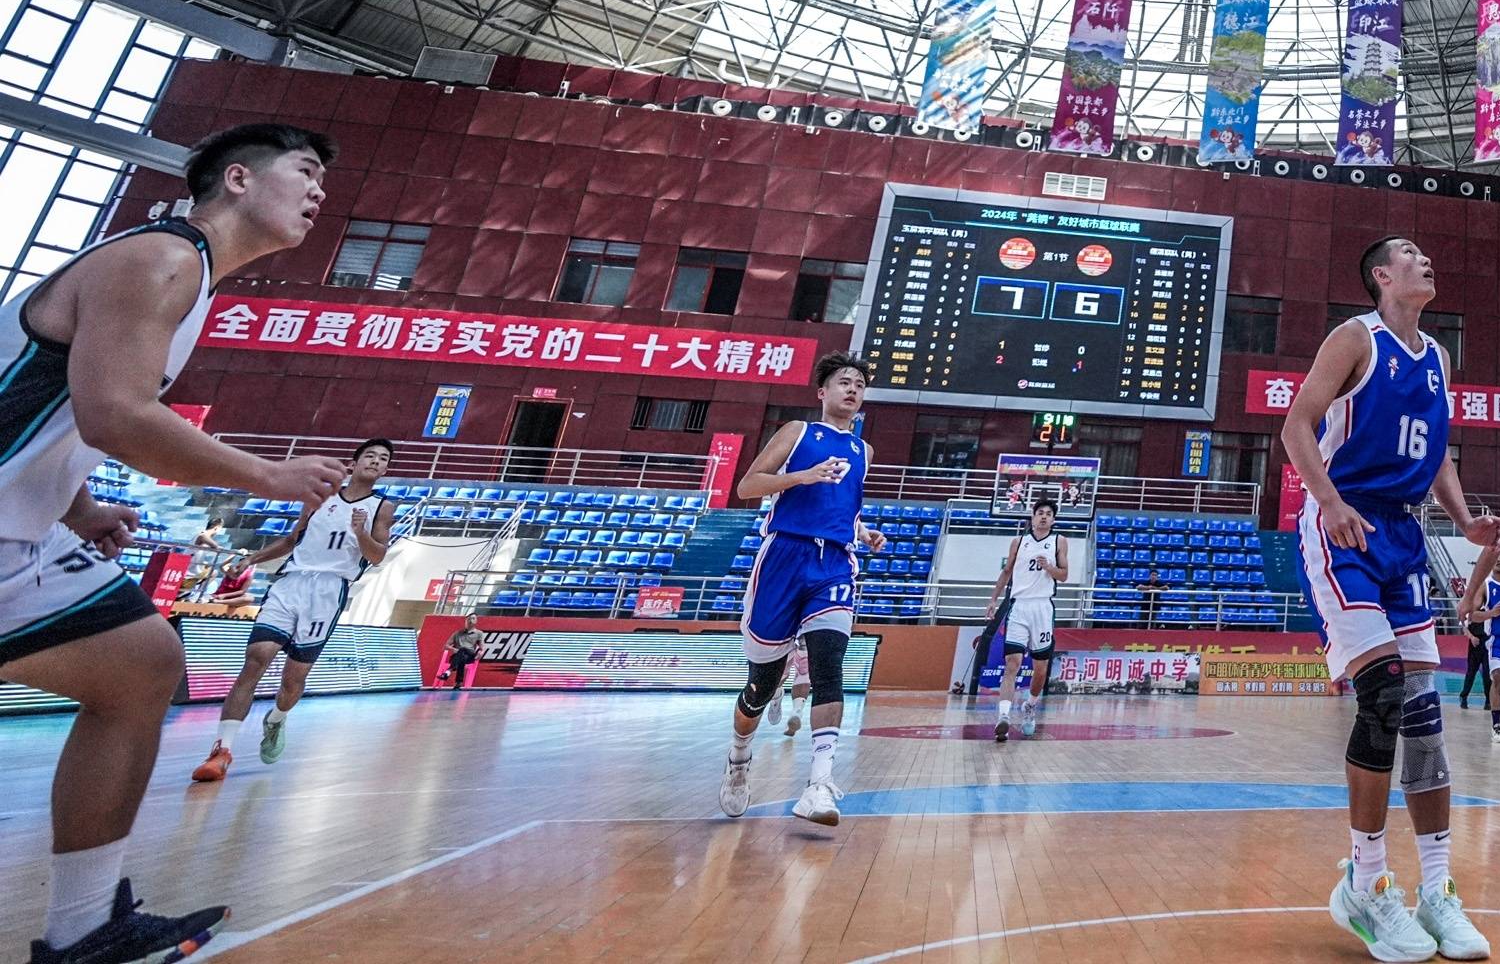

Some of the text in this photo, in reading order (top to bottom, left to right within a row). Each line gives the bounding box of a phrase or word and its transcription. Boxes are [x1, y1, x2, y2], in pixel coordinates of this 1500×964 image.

[981, 209, 1017, 221] 2024年
[1000, 286, 1100, 315] 7 6
[209, 304, 794, 377] 全面贯彻落实党的二十大精神
[999, 341, 1005, 349] 1
[1078, 346, 1086, 354] 0
[996, 356, 1004, 364] 2
[1040, 425, 1066, 442] 21
[1397, 415, 1428, 460] 16
[328, 531, 347, 550] 11
[829, 584, 851, 602] 17
[308, 622, 324, 637] 11
[1040, 632, 1050, 642] 20
[1060, 657, 1189, 683] 沿河明诚中学
